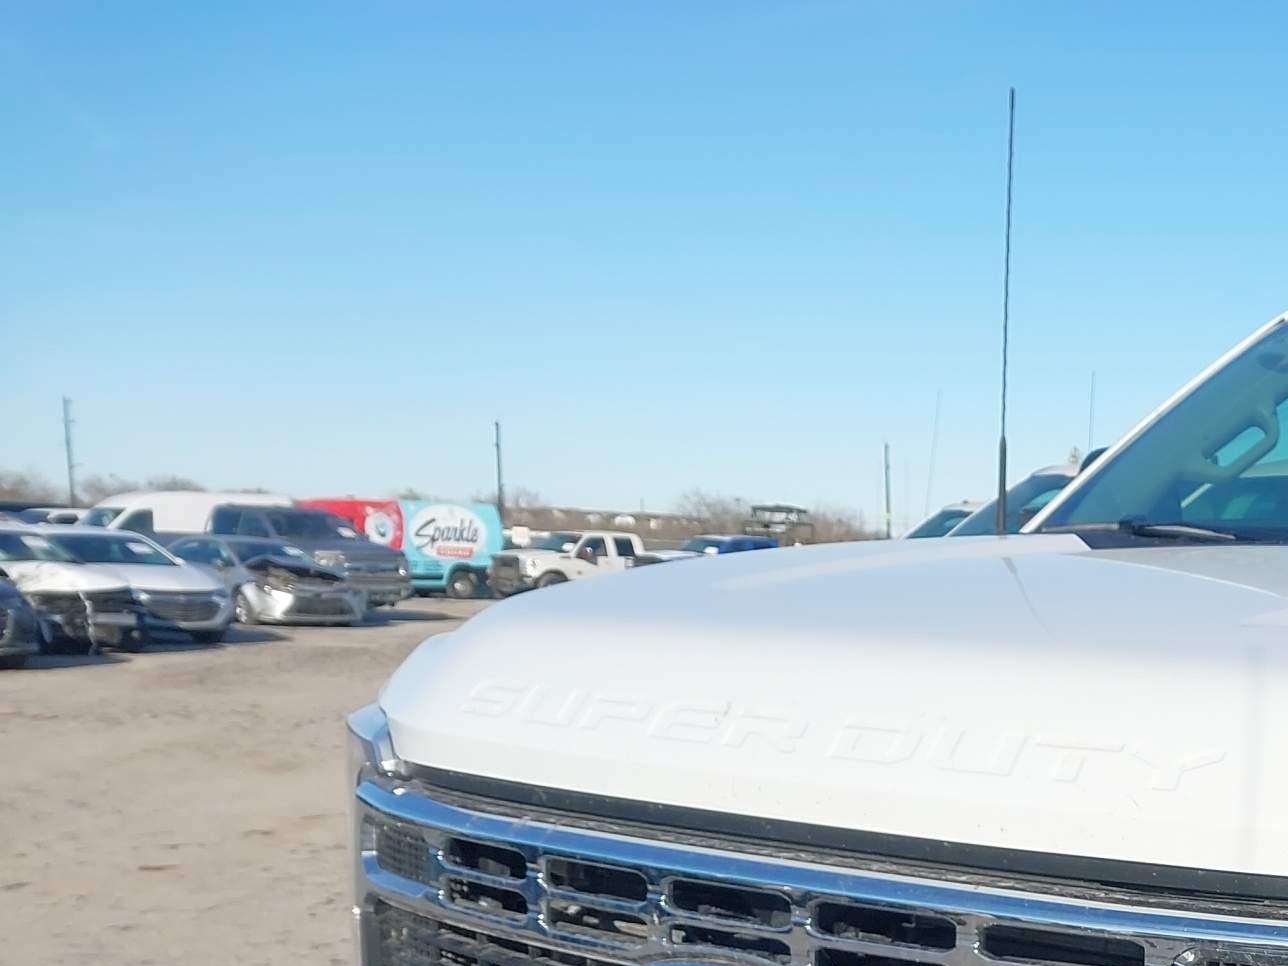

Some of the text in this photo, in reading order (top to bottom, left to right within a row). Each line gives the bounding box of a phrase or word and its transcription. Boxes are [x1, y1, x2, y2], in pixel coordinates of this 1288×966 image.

[414, 518, 479, 550] Sparkle
[457, 678, 1228, 791] SUPER DUTY
